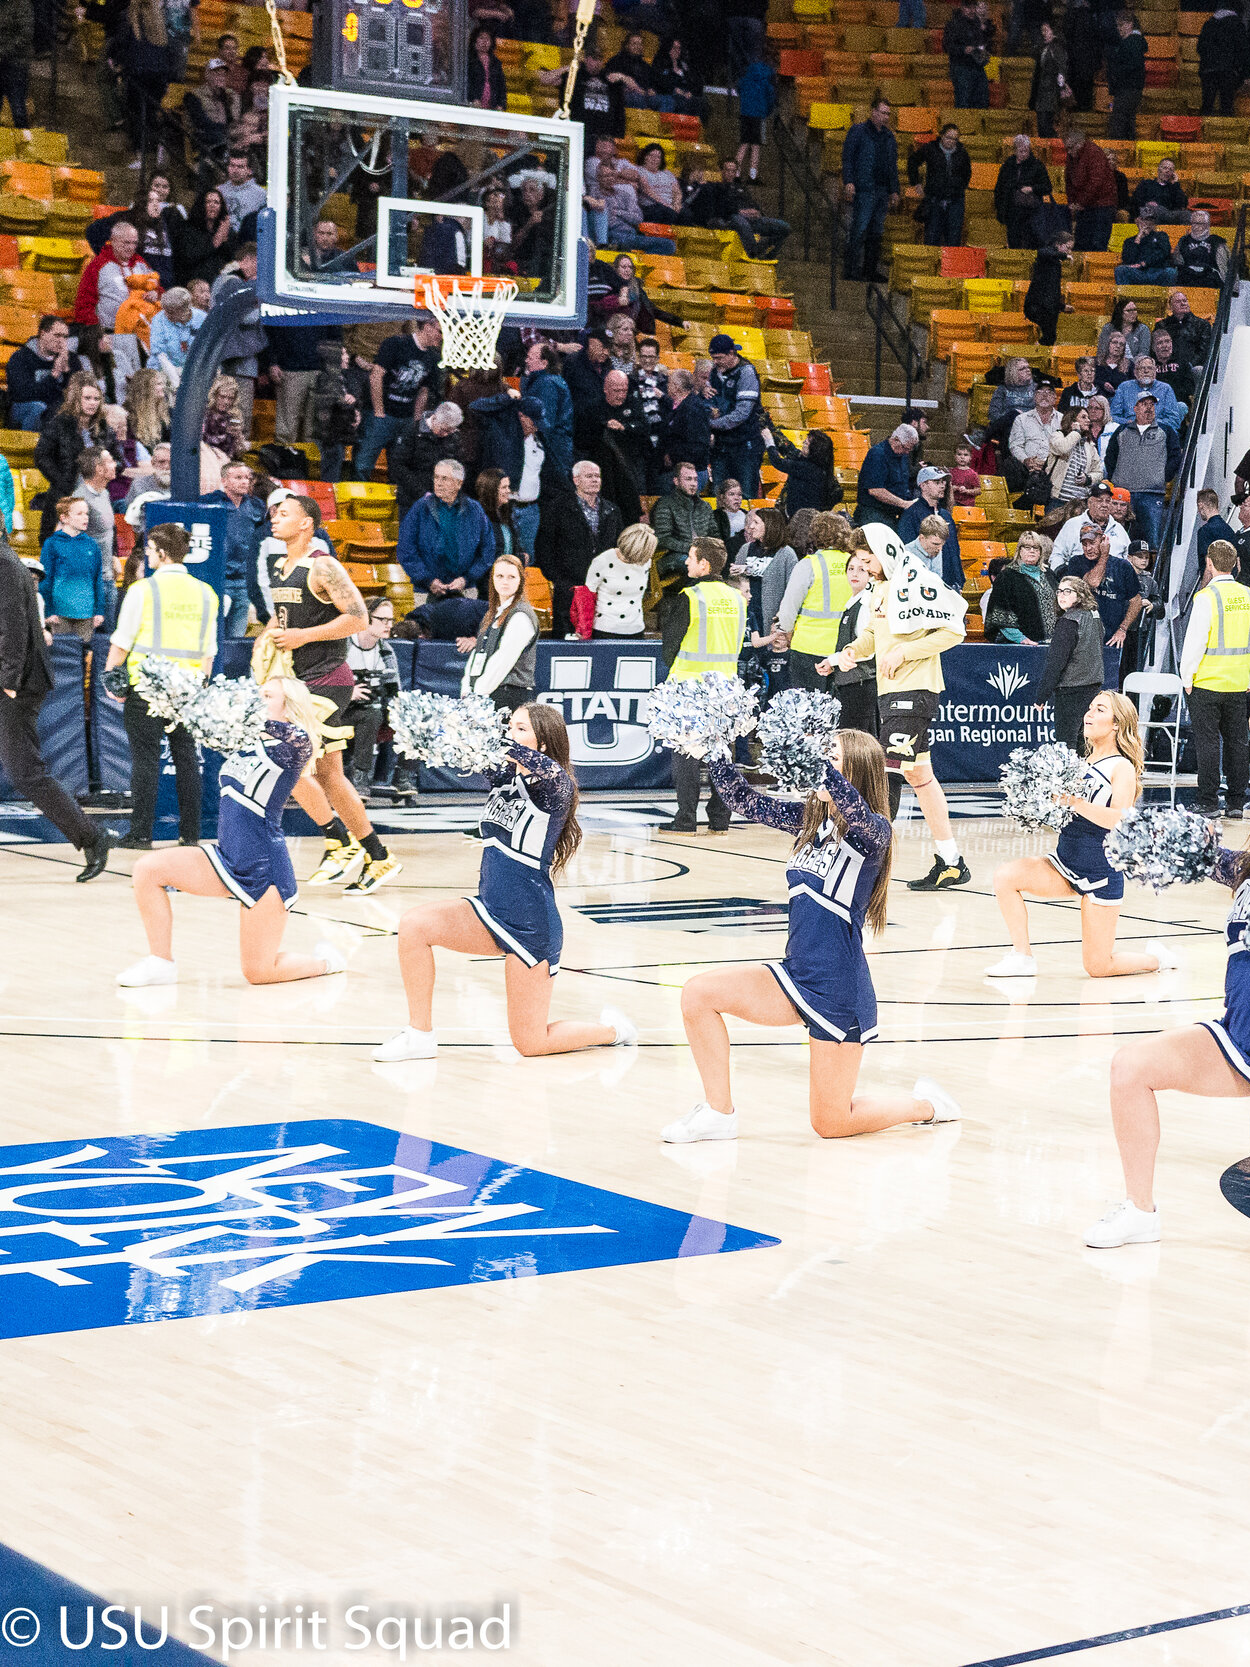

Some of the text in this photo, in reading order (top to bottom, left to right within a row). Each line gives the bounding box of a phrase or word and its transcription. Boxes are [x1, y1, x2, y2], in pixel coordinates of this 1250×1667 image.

[1225, 603, 1250, 611] SERVICES
[931, 700, 1055, 722] ntermount
[960, 725, 1032, 747] Regional
